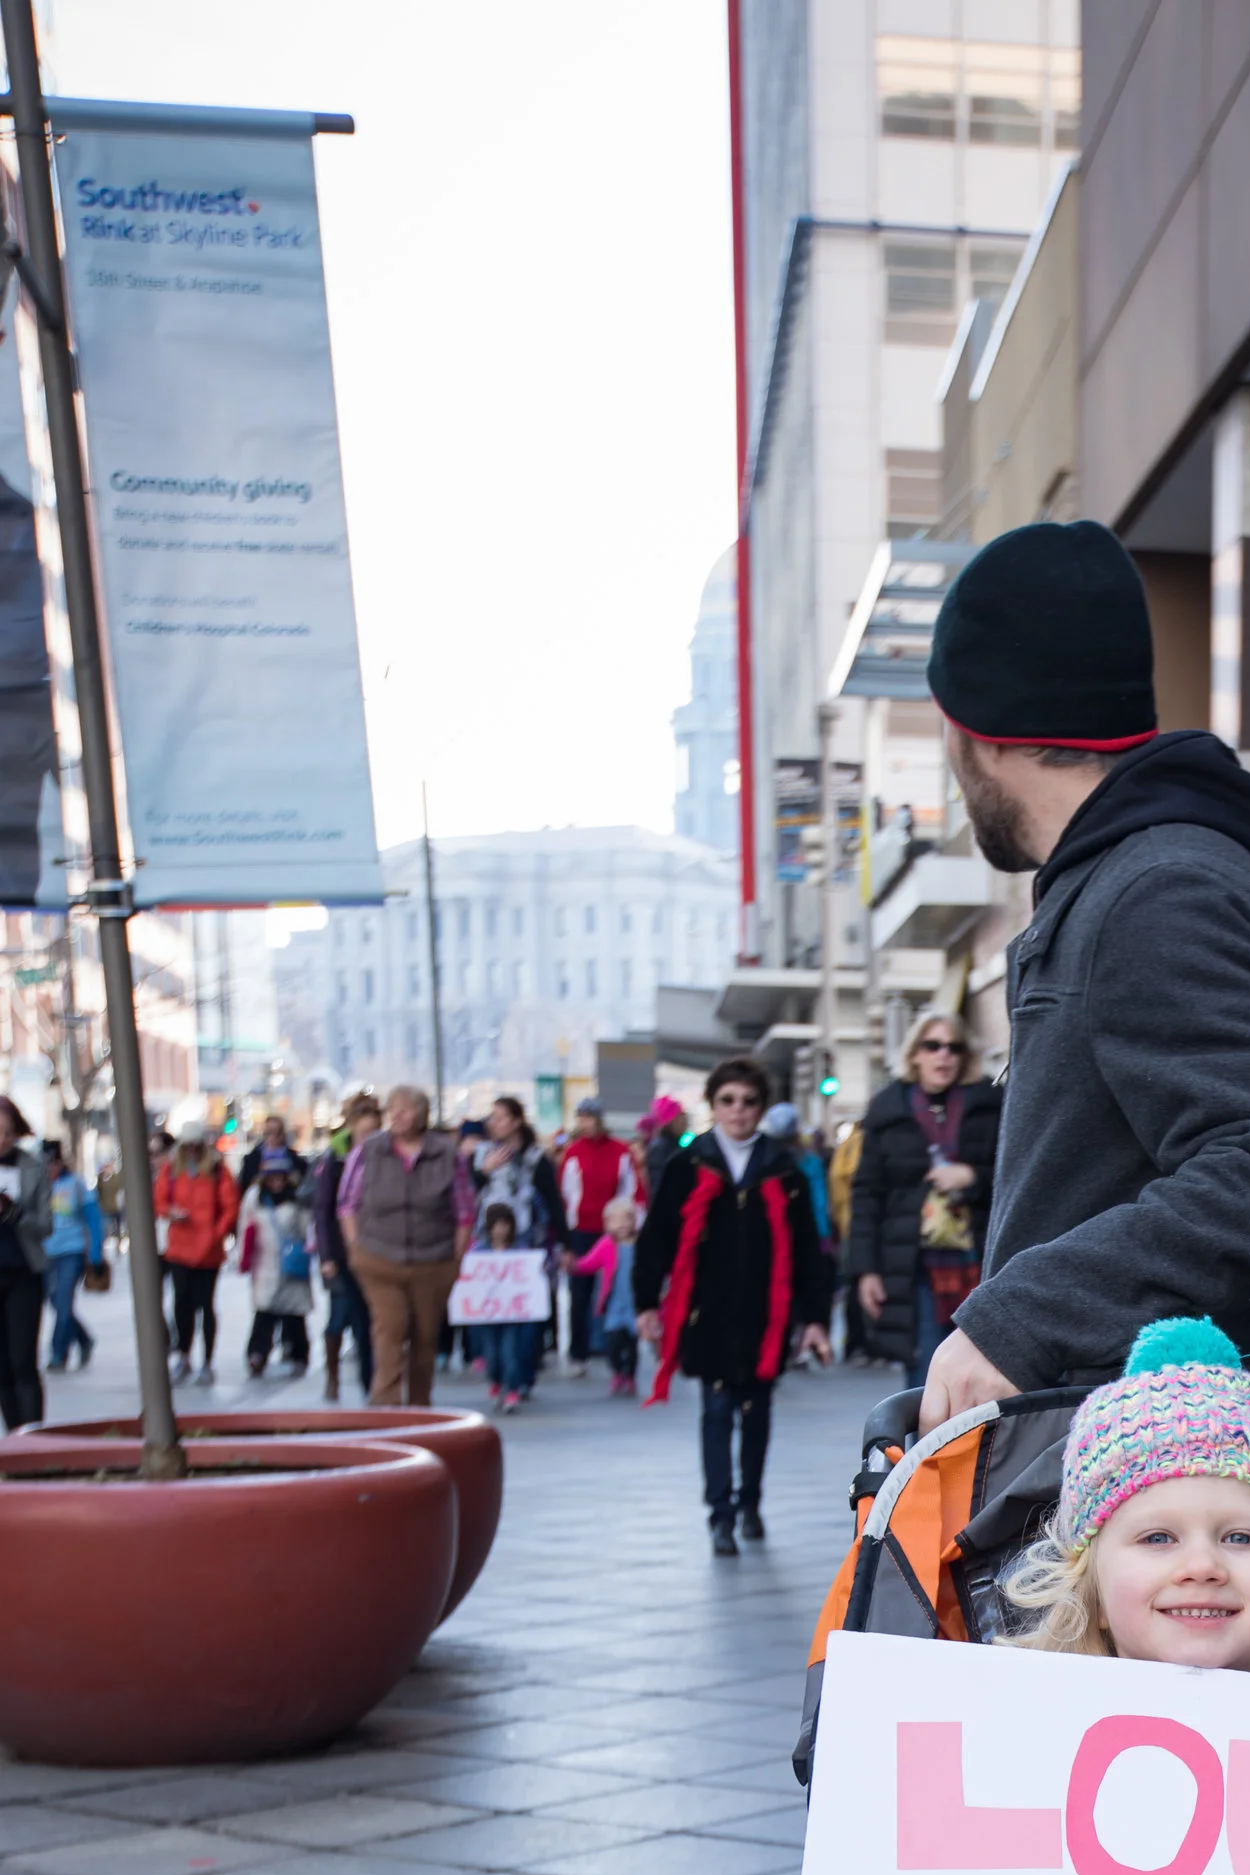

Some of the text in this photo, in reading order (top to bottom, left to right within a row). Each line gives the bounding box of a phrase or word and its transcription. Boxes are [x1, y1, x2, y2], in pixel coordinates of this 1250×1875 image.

[77, 178, 248, 216] Southwest
[81, 215, 306, 250] Rink at Skyline Park
[110, 470, 313, 505] Community giving
